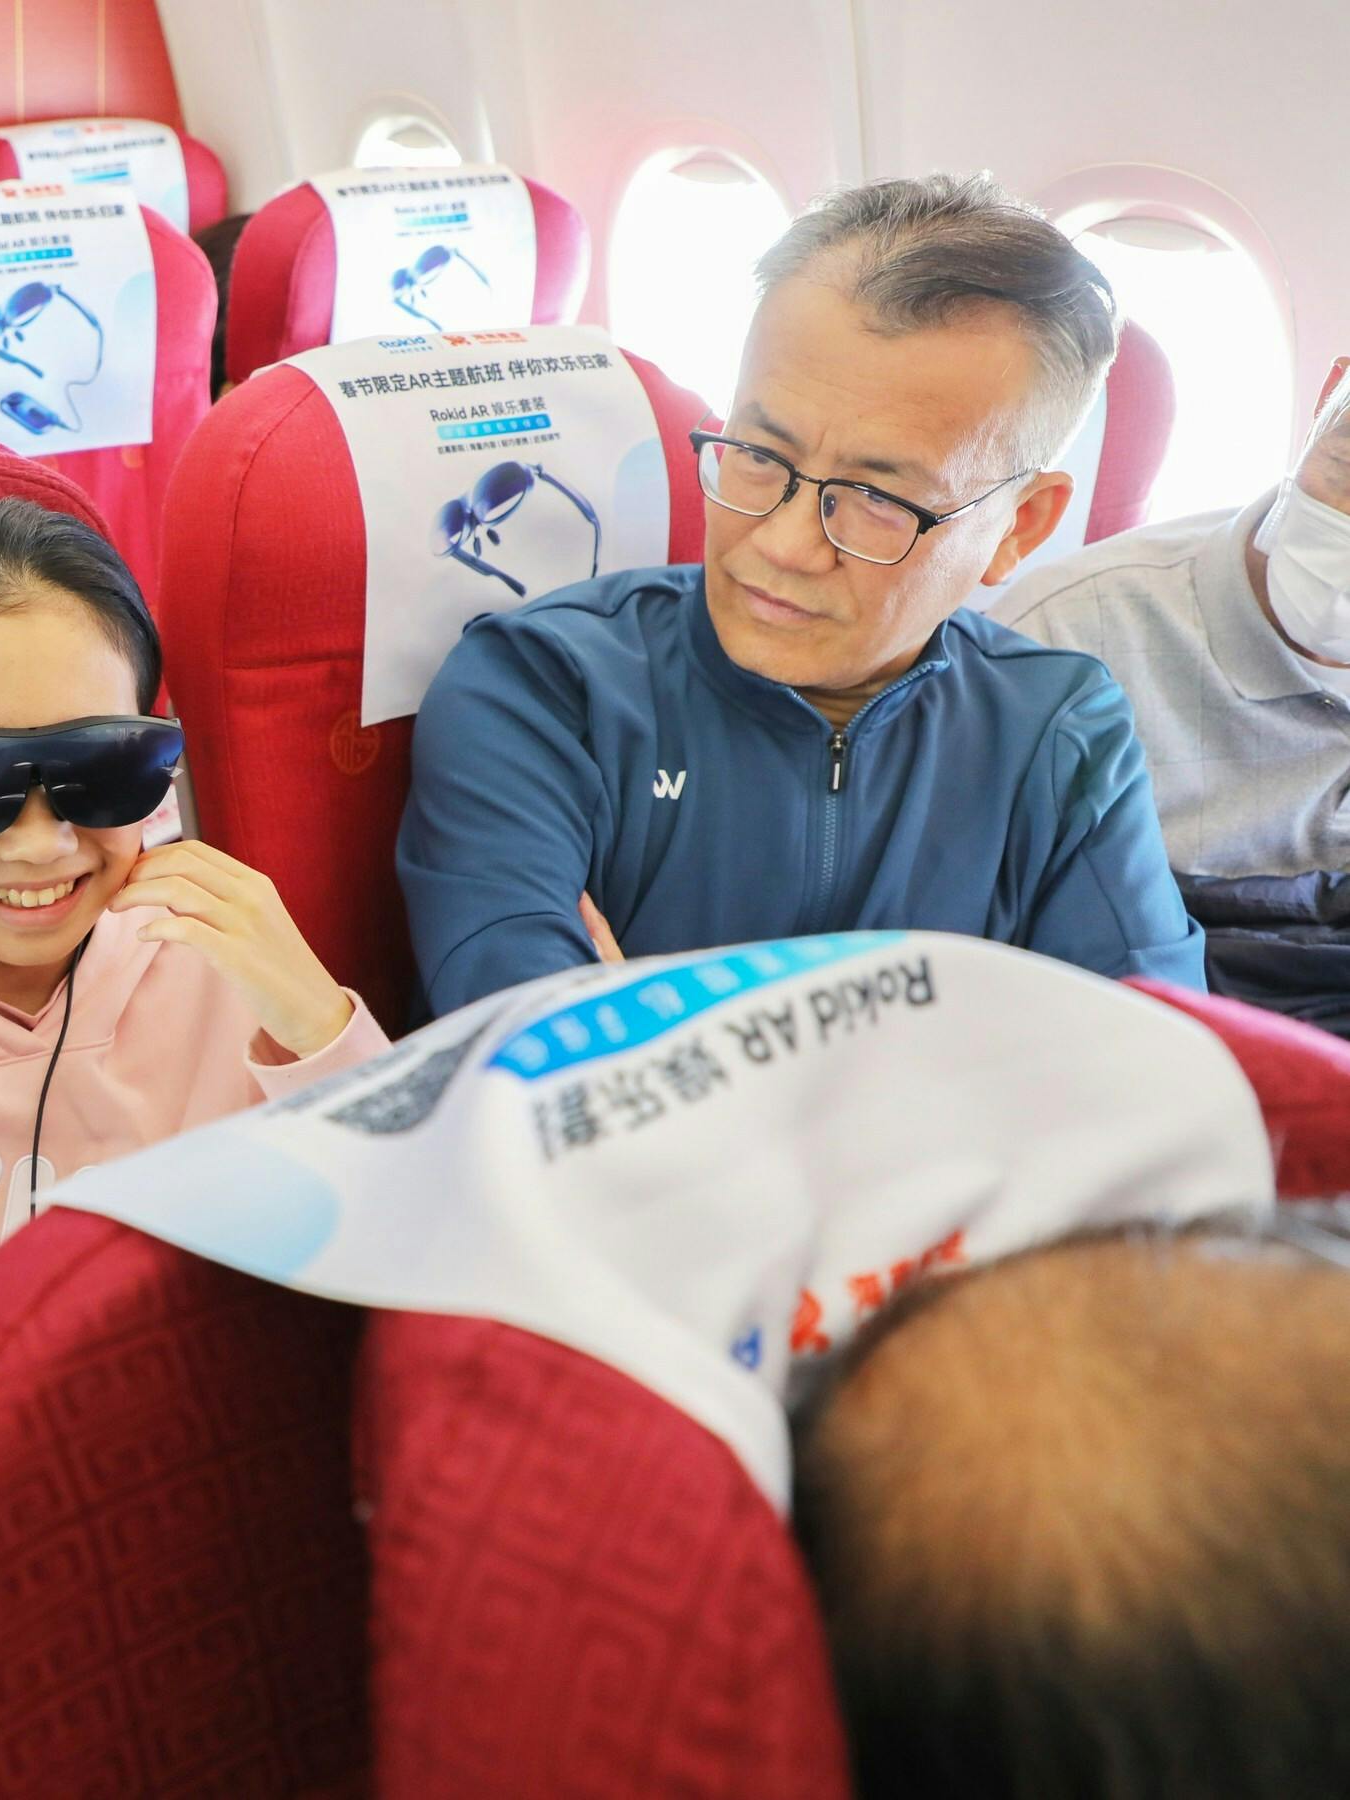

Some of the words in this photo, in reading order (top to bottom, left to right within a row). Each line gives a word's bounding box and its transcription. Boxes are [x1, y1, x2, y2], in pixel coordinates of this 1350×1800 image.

[338, 363, 504, 398] 春节限定AR主题航班
[508, 353, 612, 379] 伴你欢乐归家
[430, 408, 468, 422] Rokid
[470, 405, 490, 418] AR
[808, 952, 936, 1045] Rokid
[727, 1005, 799, 1067] AR
